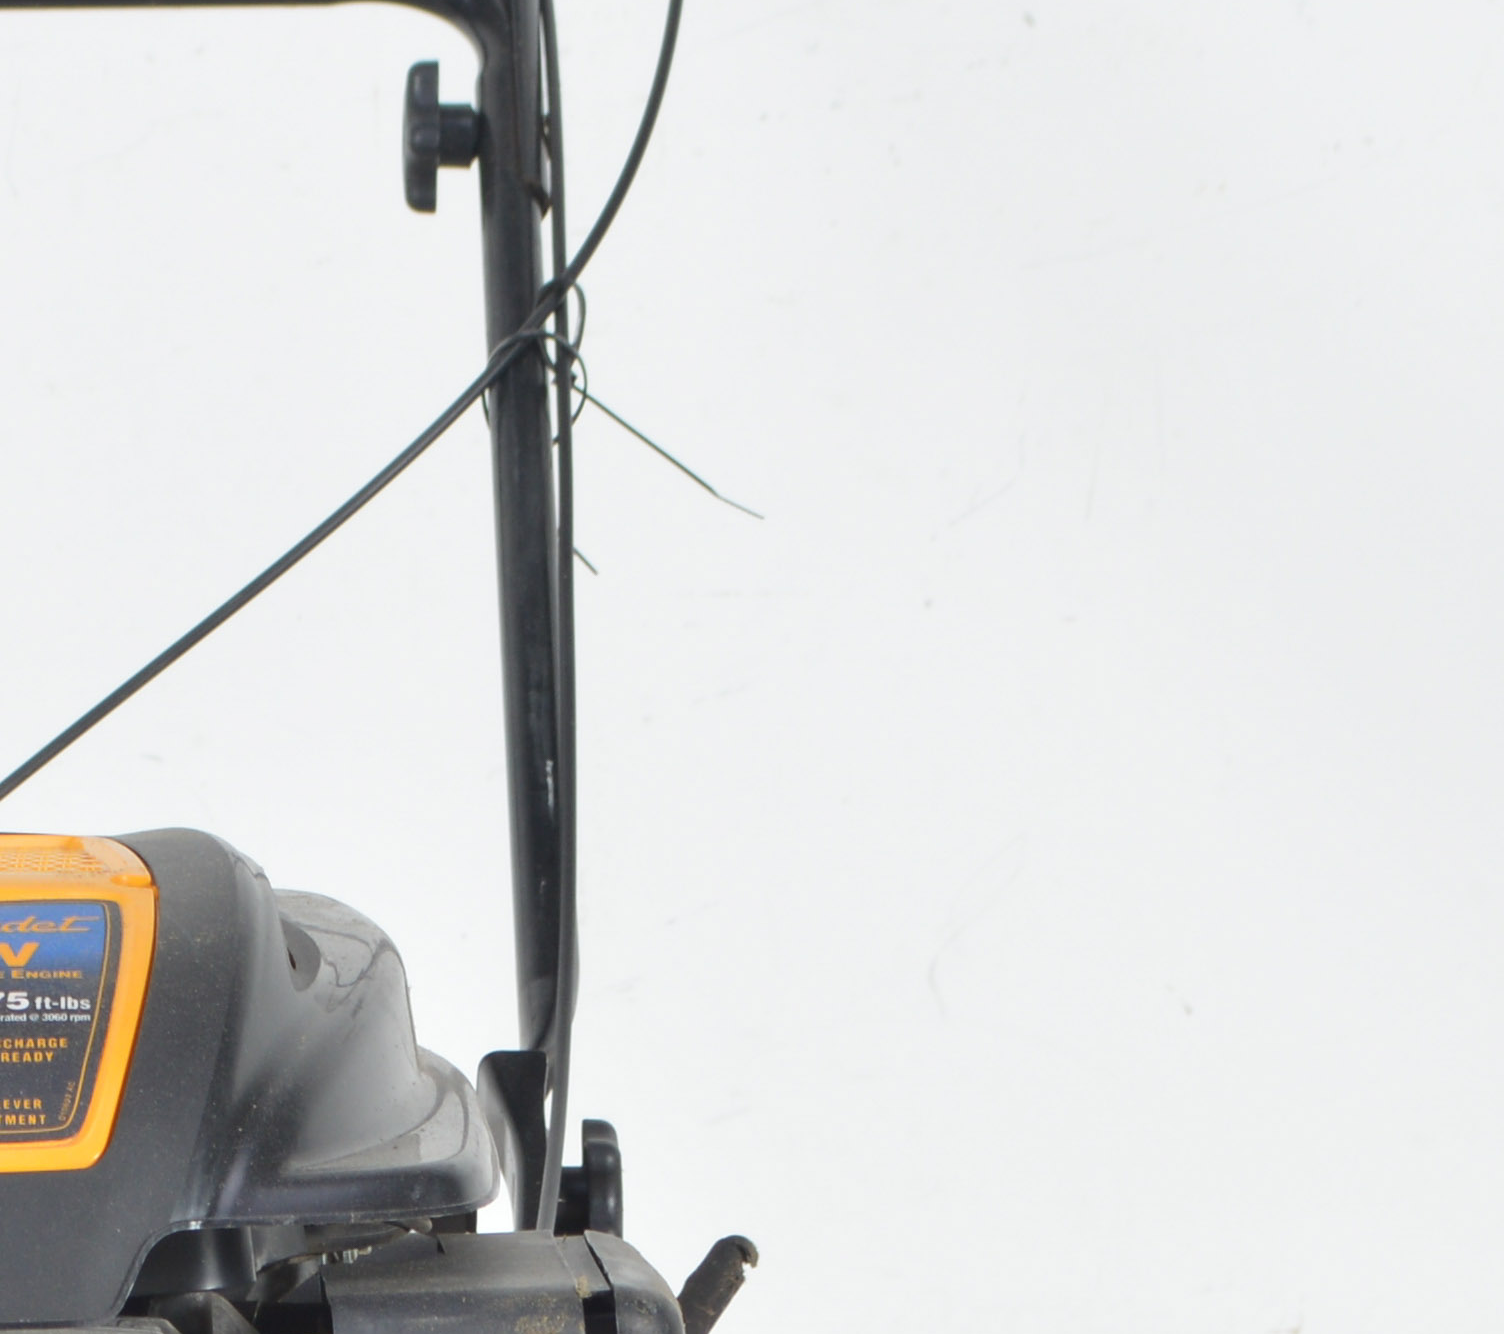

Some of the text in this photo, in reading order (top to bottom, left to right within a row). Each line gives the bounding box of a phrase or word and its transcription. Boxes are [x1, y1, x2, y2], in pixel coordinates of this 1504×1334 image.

[11, 969, 83, 980] ENGINE
[34, 996, 91, 1010] ft-lbs
[0, 1013, 27, 1023] rated
[69, 1013, 91, 1024] rpm
[1, 1051, 54, 1063] READY
